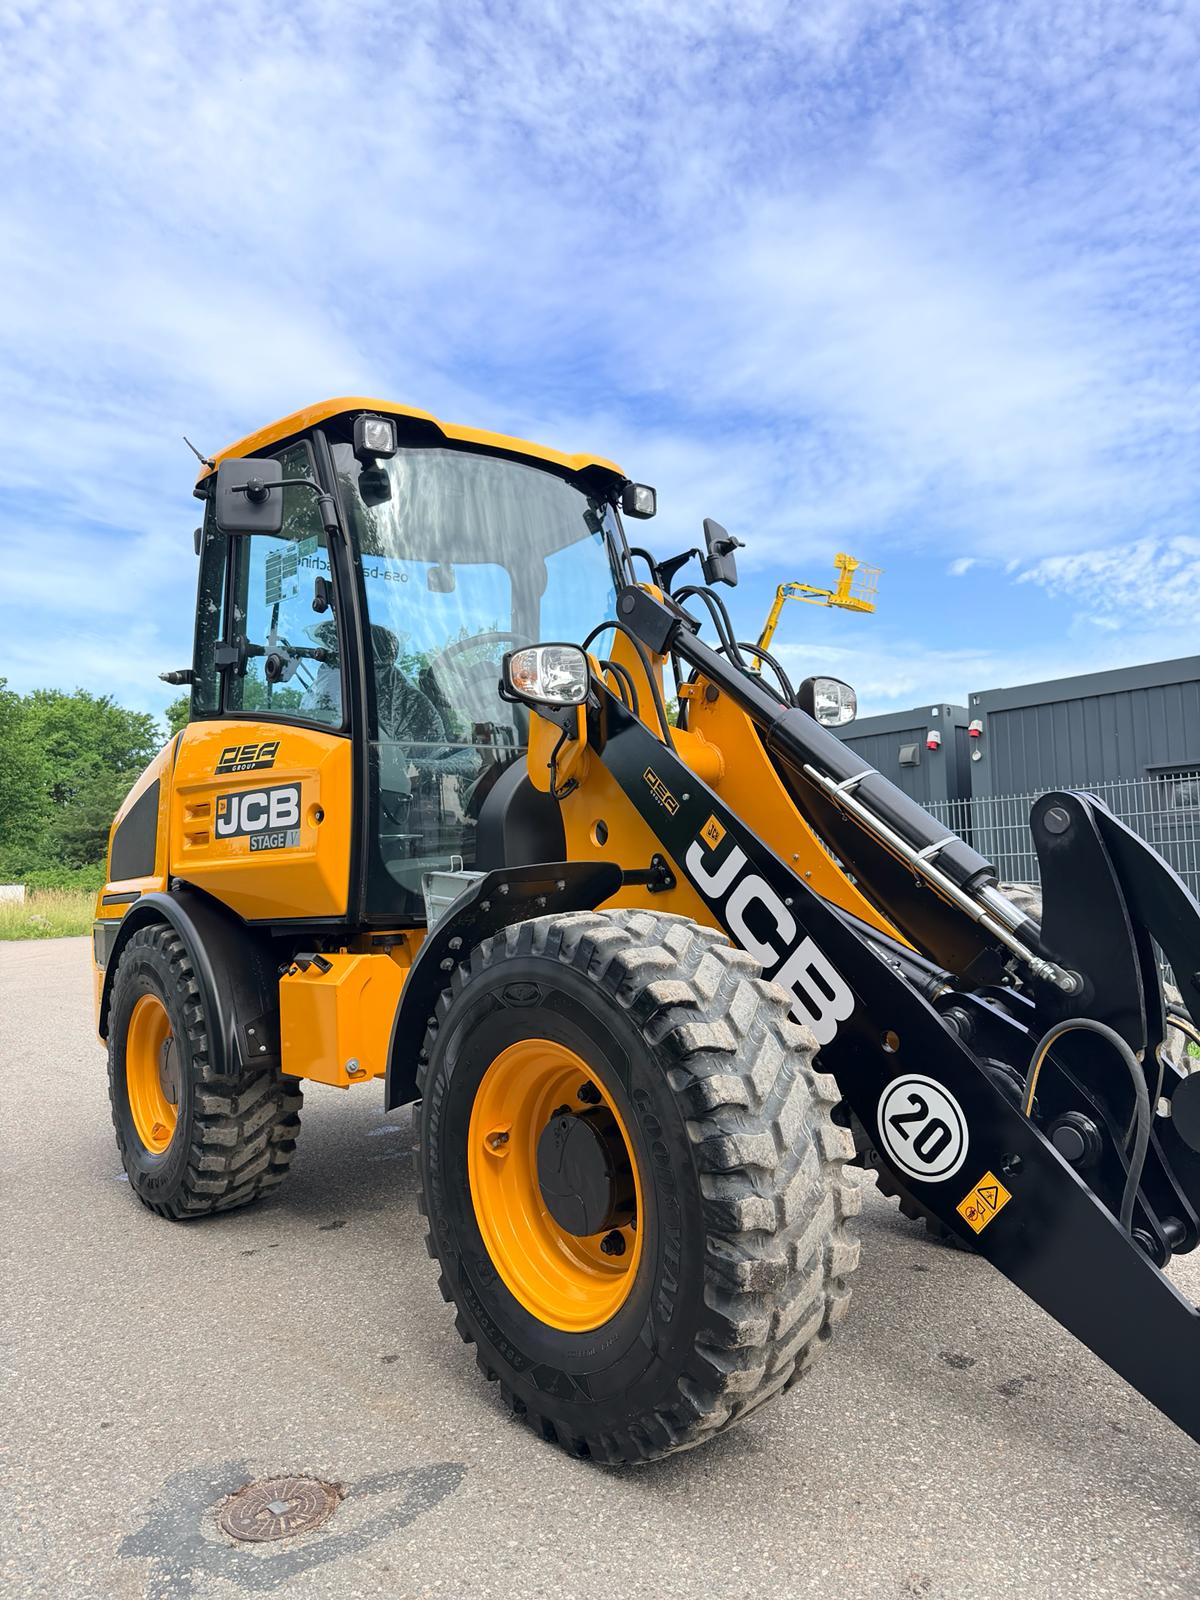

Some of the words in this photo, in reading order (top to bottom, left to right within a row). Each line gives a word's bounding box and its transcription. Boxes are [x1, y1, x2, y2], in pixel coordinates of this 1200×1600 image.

[231, 763, 256, 772] GROUP
[217, 787, 299, 835] JCB
[251, 833, 284, 850] STAGE
[685, 839, 855, 1046] JCB
[888, 1093, 953, 1165] 20
